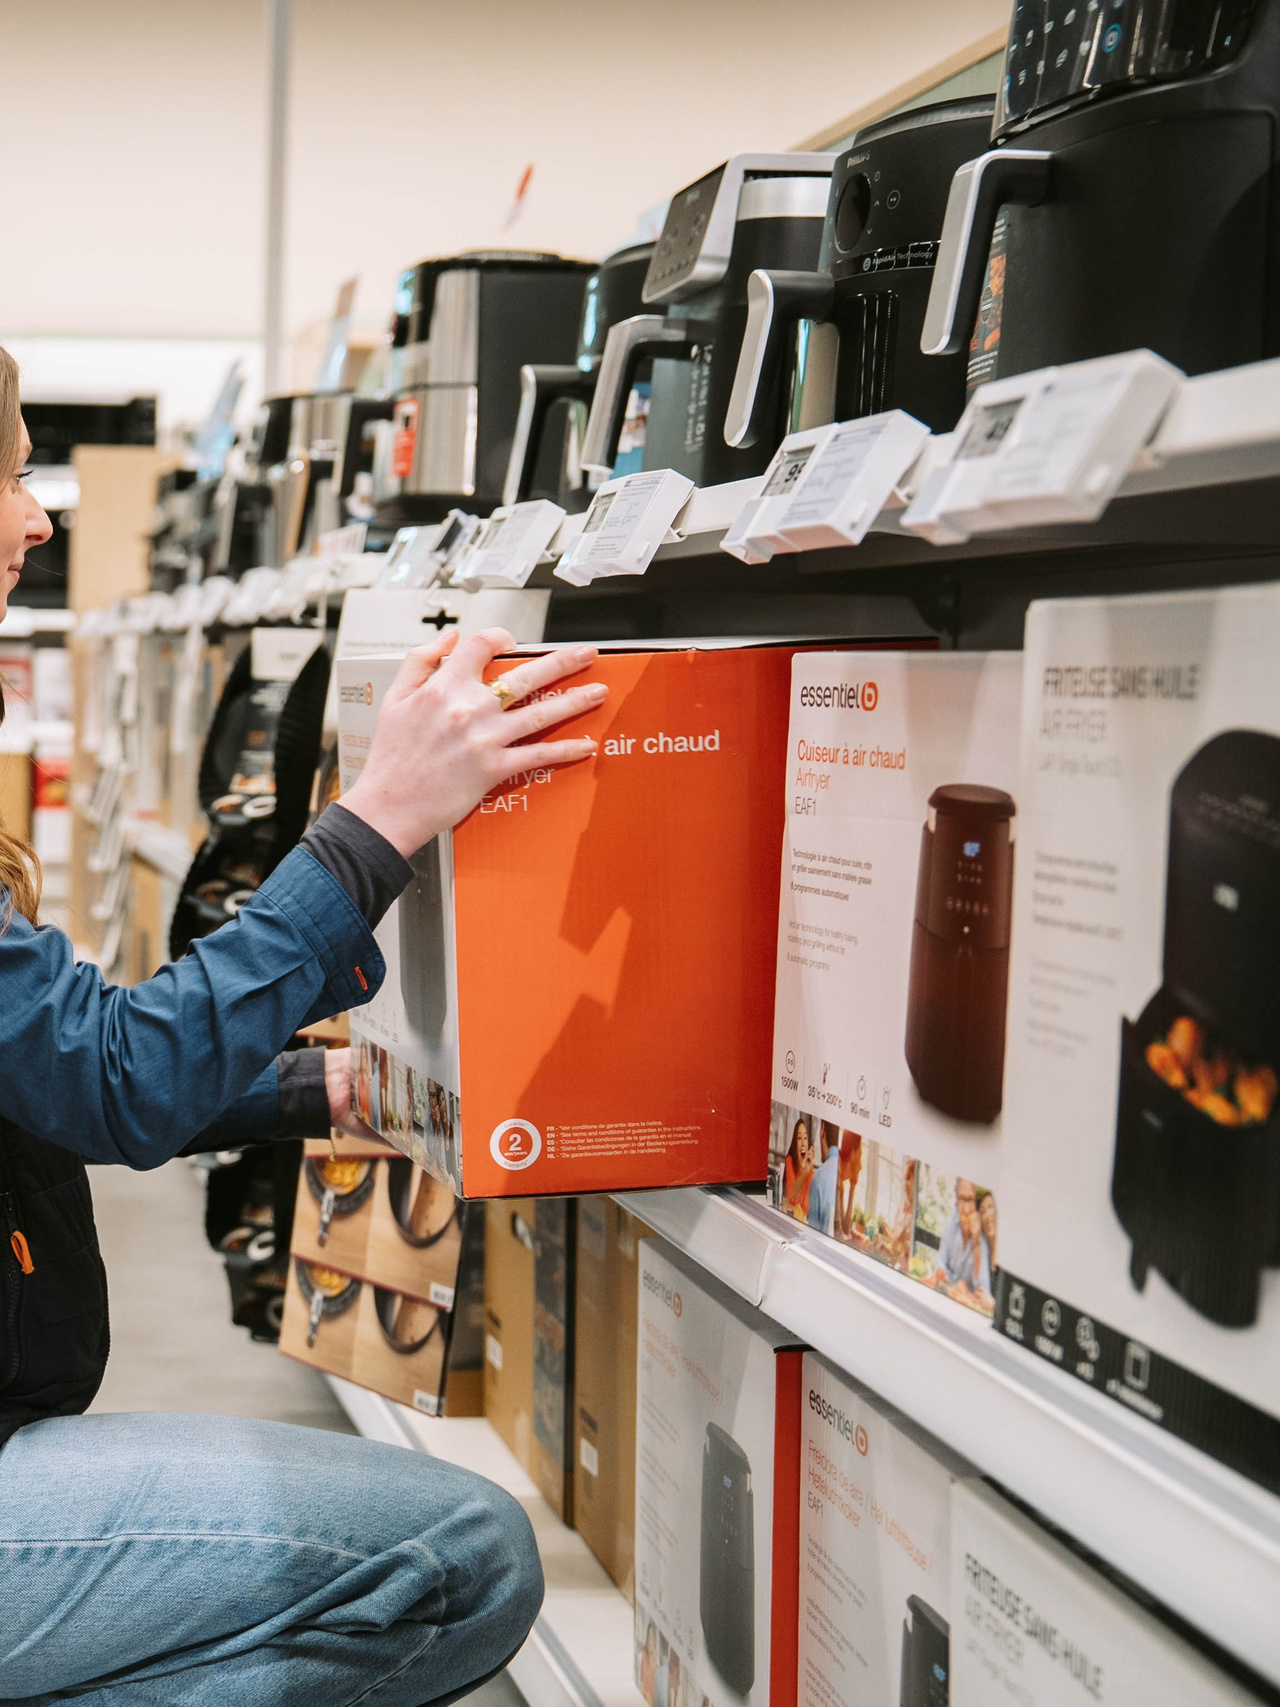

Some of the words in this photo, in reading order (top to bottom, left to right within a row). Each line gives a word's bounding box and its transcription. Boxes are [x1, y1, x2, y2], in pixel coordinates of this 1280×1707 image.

[847, 150, 871, 168] PHILIPS
[604, 734, 636, 755] air
[644, 729, 720, 755] chaud
[797, 739, 840, 764] Cuiseur
[842, 743, 849, 765] à
[852, 744, 865, 767] air
[869, 746, 906, 770] chaud
[795, 766, 831, 792] Airfryer
[480, 794, 528, 814] EAF1
[795, 796, 817, 816] EAF1
[781, 1075, 799, 1092] 1500W
[879, 1112, 892, 1128] LED
[509, 1133, 522, 1151] 2
[807, 1491, 823, 1519] EAF1
